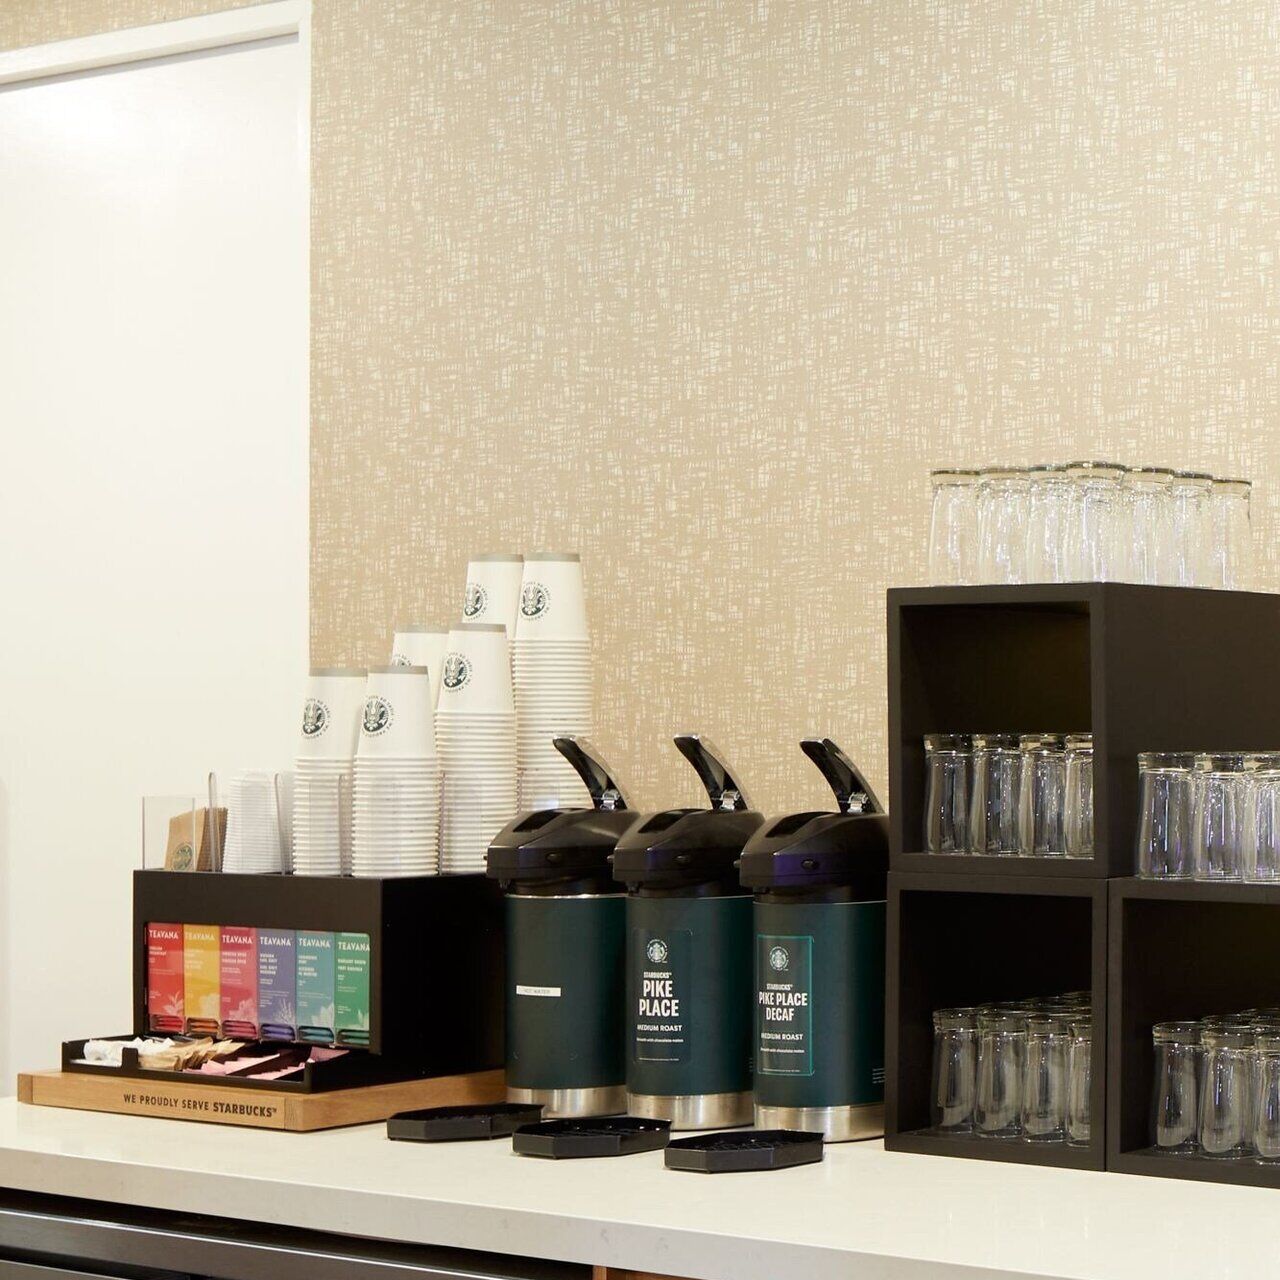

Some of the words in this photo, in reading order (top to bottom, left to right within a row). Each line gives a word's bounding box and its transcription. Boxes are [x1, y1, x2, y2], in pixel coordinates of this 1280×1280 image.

[149, 929, 179, 940] TEAVANA
[222, 934, 253, 944] TEAVANA
[259, 936, 292, 947] TEAVANA
[298, 937, 331, 948] TEAVANA
[338, 941, 370, 952] TEAVANA
[643, 980, 673, 998] PIKE
[759, 992, 775, 1006] PIKE
[776, 993, 808, 1007] PLACE
[639, 999, 680, 1017] PLACE
[766, 1007, 795, 1021] DECAF
[637, 1024, 659, 1032] MEDIUM
[761, 1032, 781, 1040] MEDIUM
[782, 1033, 804, 1041] ROAST
[123, 1094, 136, 1104] WE
[140, 1095, 179, 1108] PROUDLY
[182, 1099, 209, 1111] SERVE
